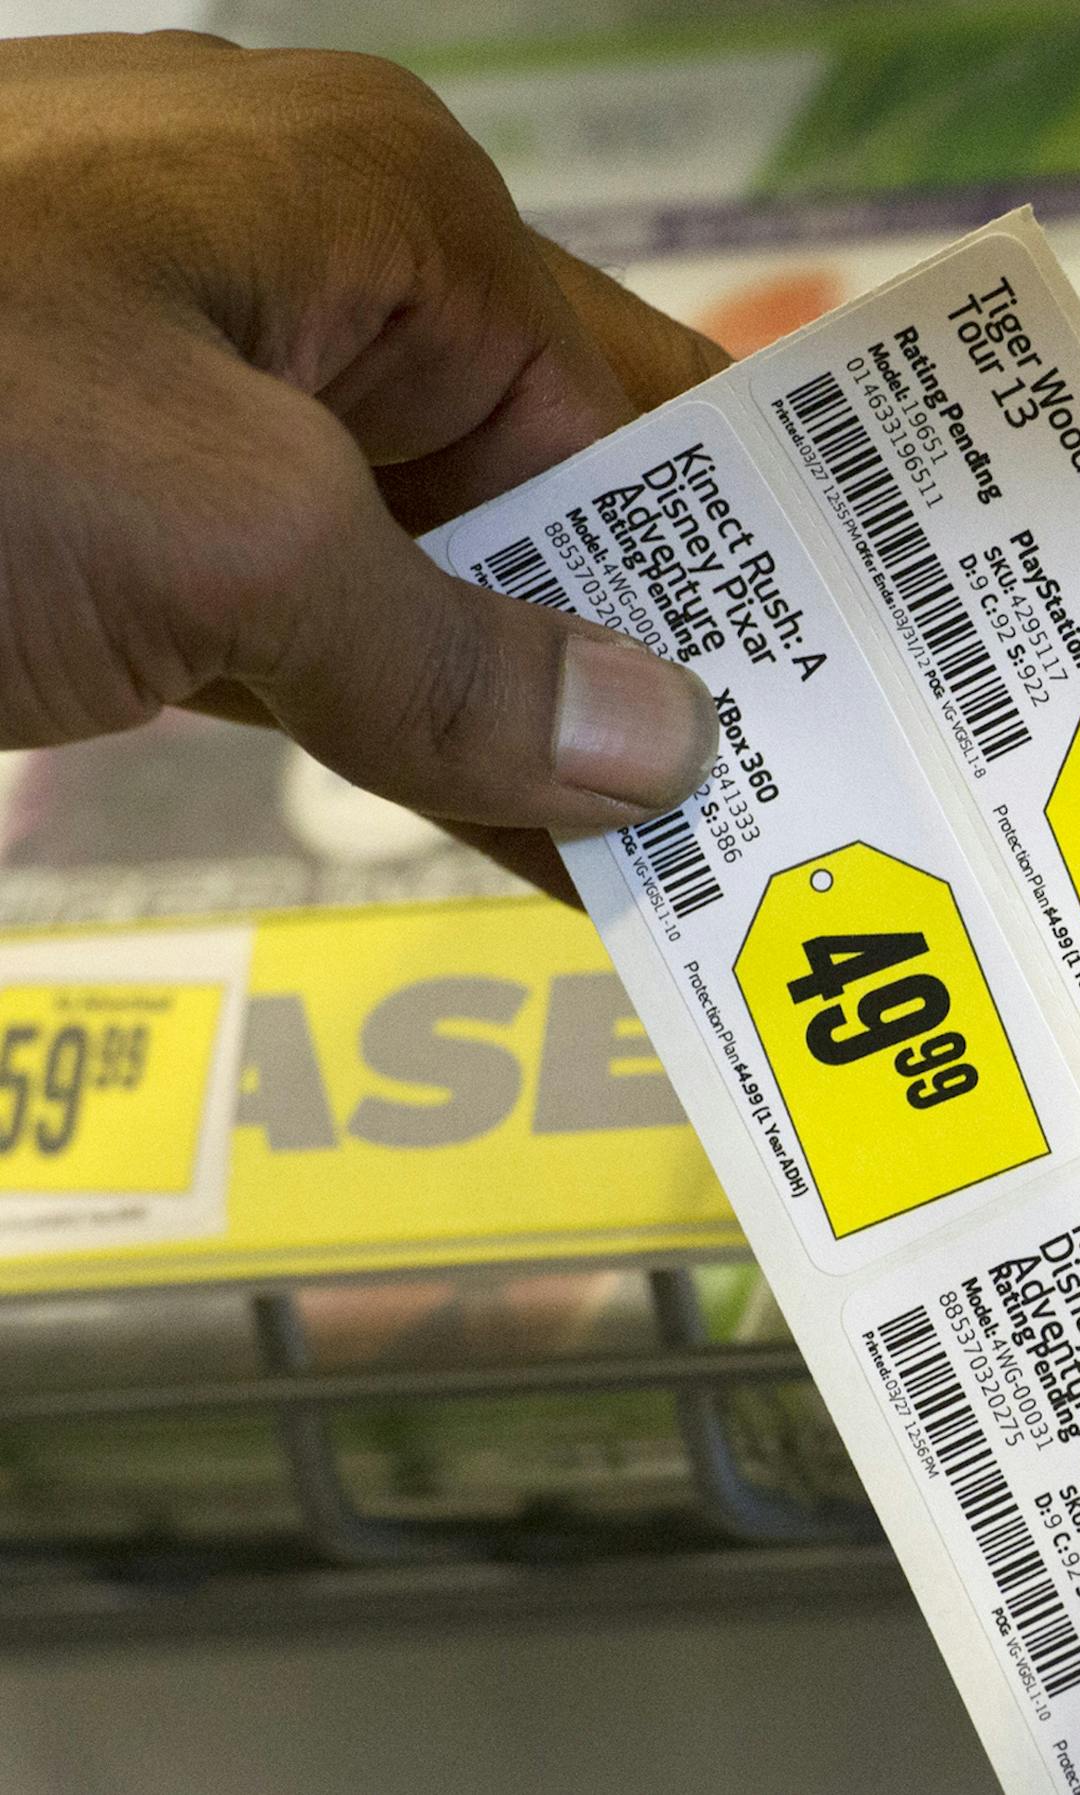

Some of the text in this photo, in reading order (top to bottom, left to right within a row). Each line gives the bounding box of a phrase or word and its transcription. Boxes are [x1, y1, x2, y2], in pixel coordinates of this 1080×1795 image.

[948, 294, 1039, 428] Tour 13
[980, 277, 1042, 368] Tiger
[847, 358, 943, 508] 014633196511
[894, 326, 1002, 504] Rating Pending
[592, 490, 701, 662] Rating Pending
[609, 483, 725, 652] Adventure
[636, 460, 776, 663] Disney Pixar
[673, 443, 827, 682] Kinect Rush: A
[843, 519, 862, 541] PM
[856, 541, 877, 572] Offer
[713, 689, 779, 803] XBox 360
[993, 804, 1033, 877] Protection
[1028, 875, 1051, 908] Plan
[1043, 907, 1073, 948] $4.99
[1062, 950, 1080, 968] (1
[684, 961, 808, 1197] Protection Plan $4.99 (1 Year ADH)
[940, 1291, 1024, 1446] 885370320275
[988, 1262, 1043, 1346] Rating
[922, 1456, 939, 1478] PM
